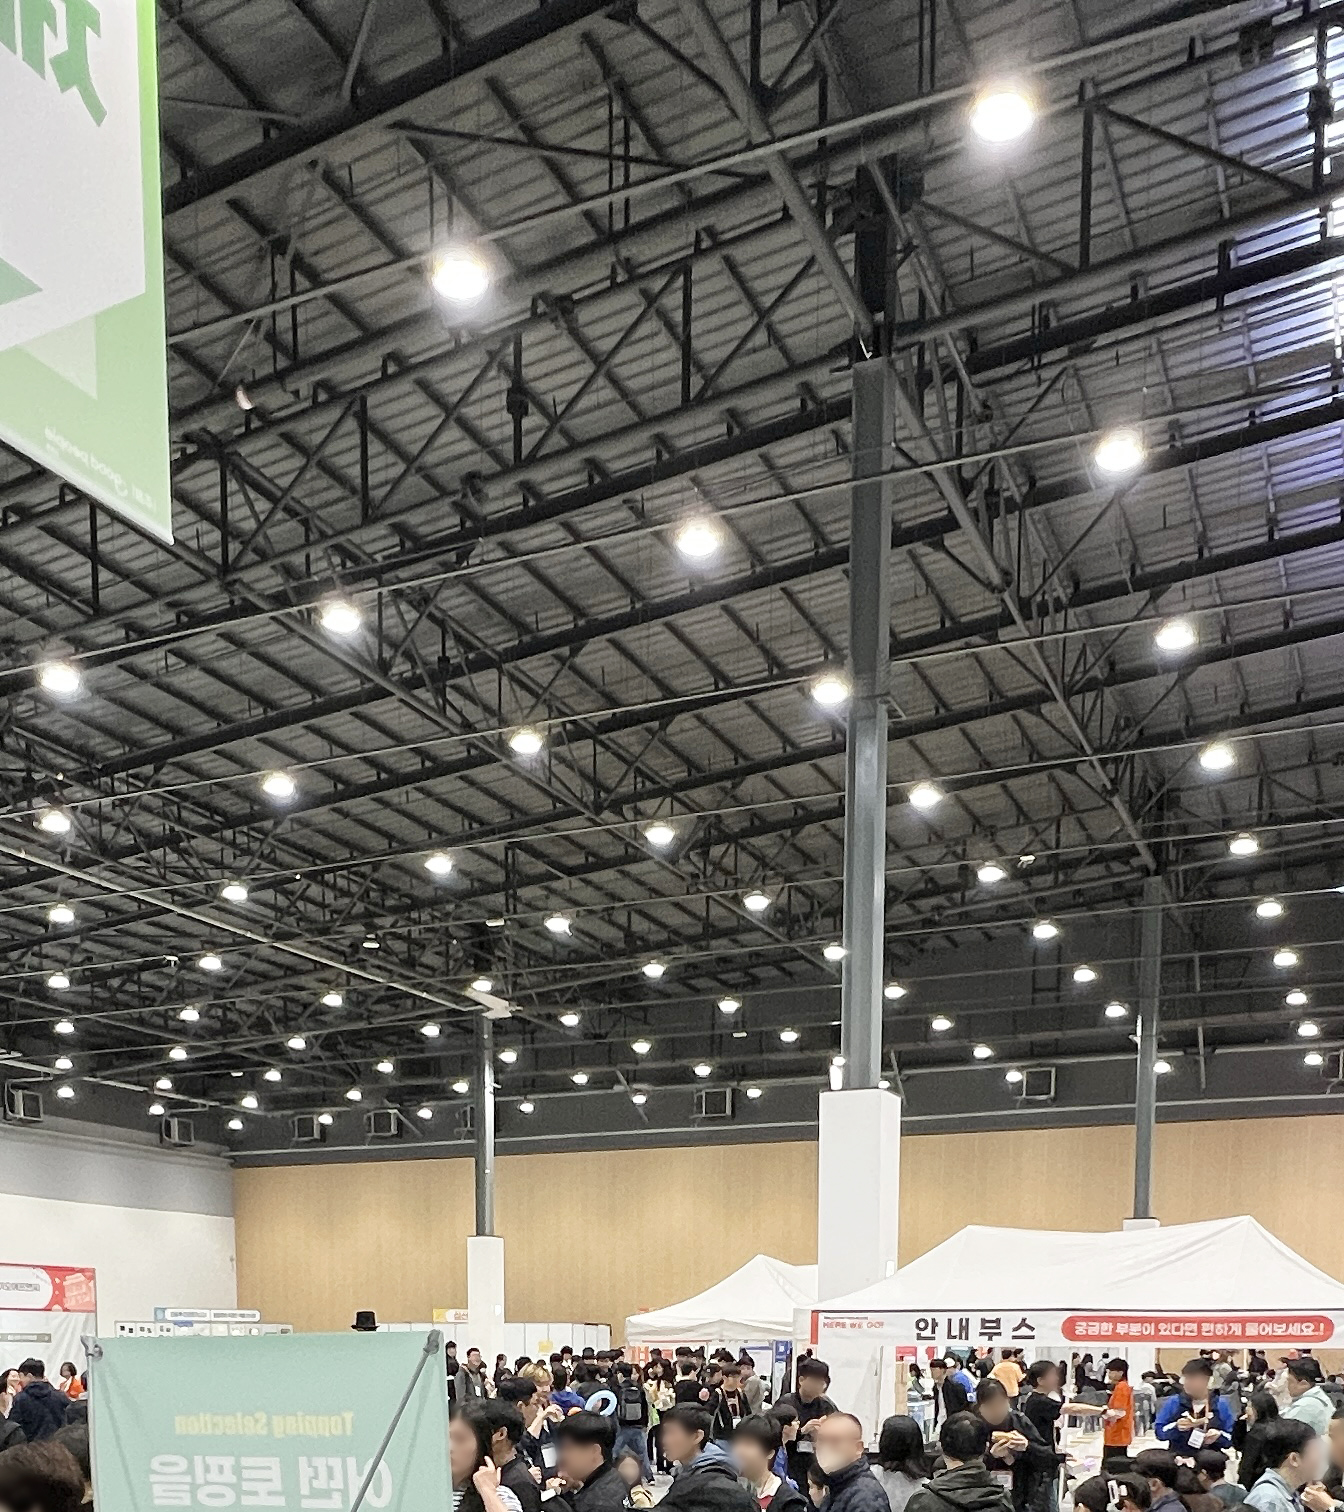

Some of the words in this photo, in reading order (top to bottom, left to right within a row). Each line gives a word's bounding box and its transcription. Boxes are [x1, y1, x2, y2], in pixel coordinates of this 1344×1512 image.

[914, 1317, 1036, 1342] 안내부스
[1074, 1322, 1114, 1336] 궁금한
[1116, 1322, 1155, 1336] 부분이
[1157, 1322, 1197, 1336] 있다면
[1200, 1322, 1242, 1336] 편하게
